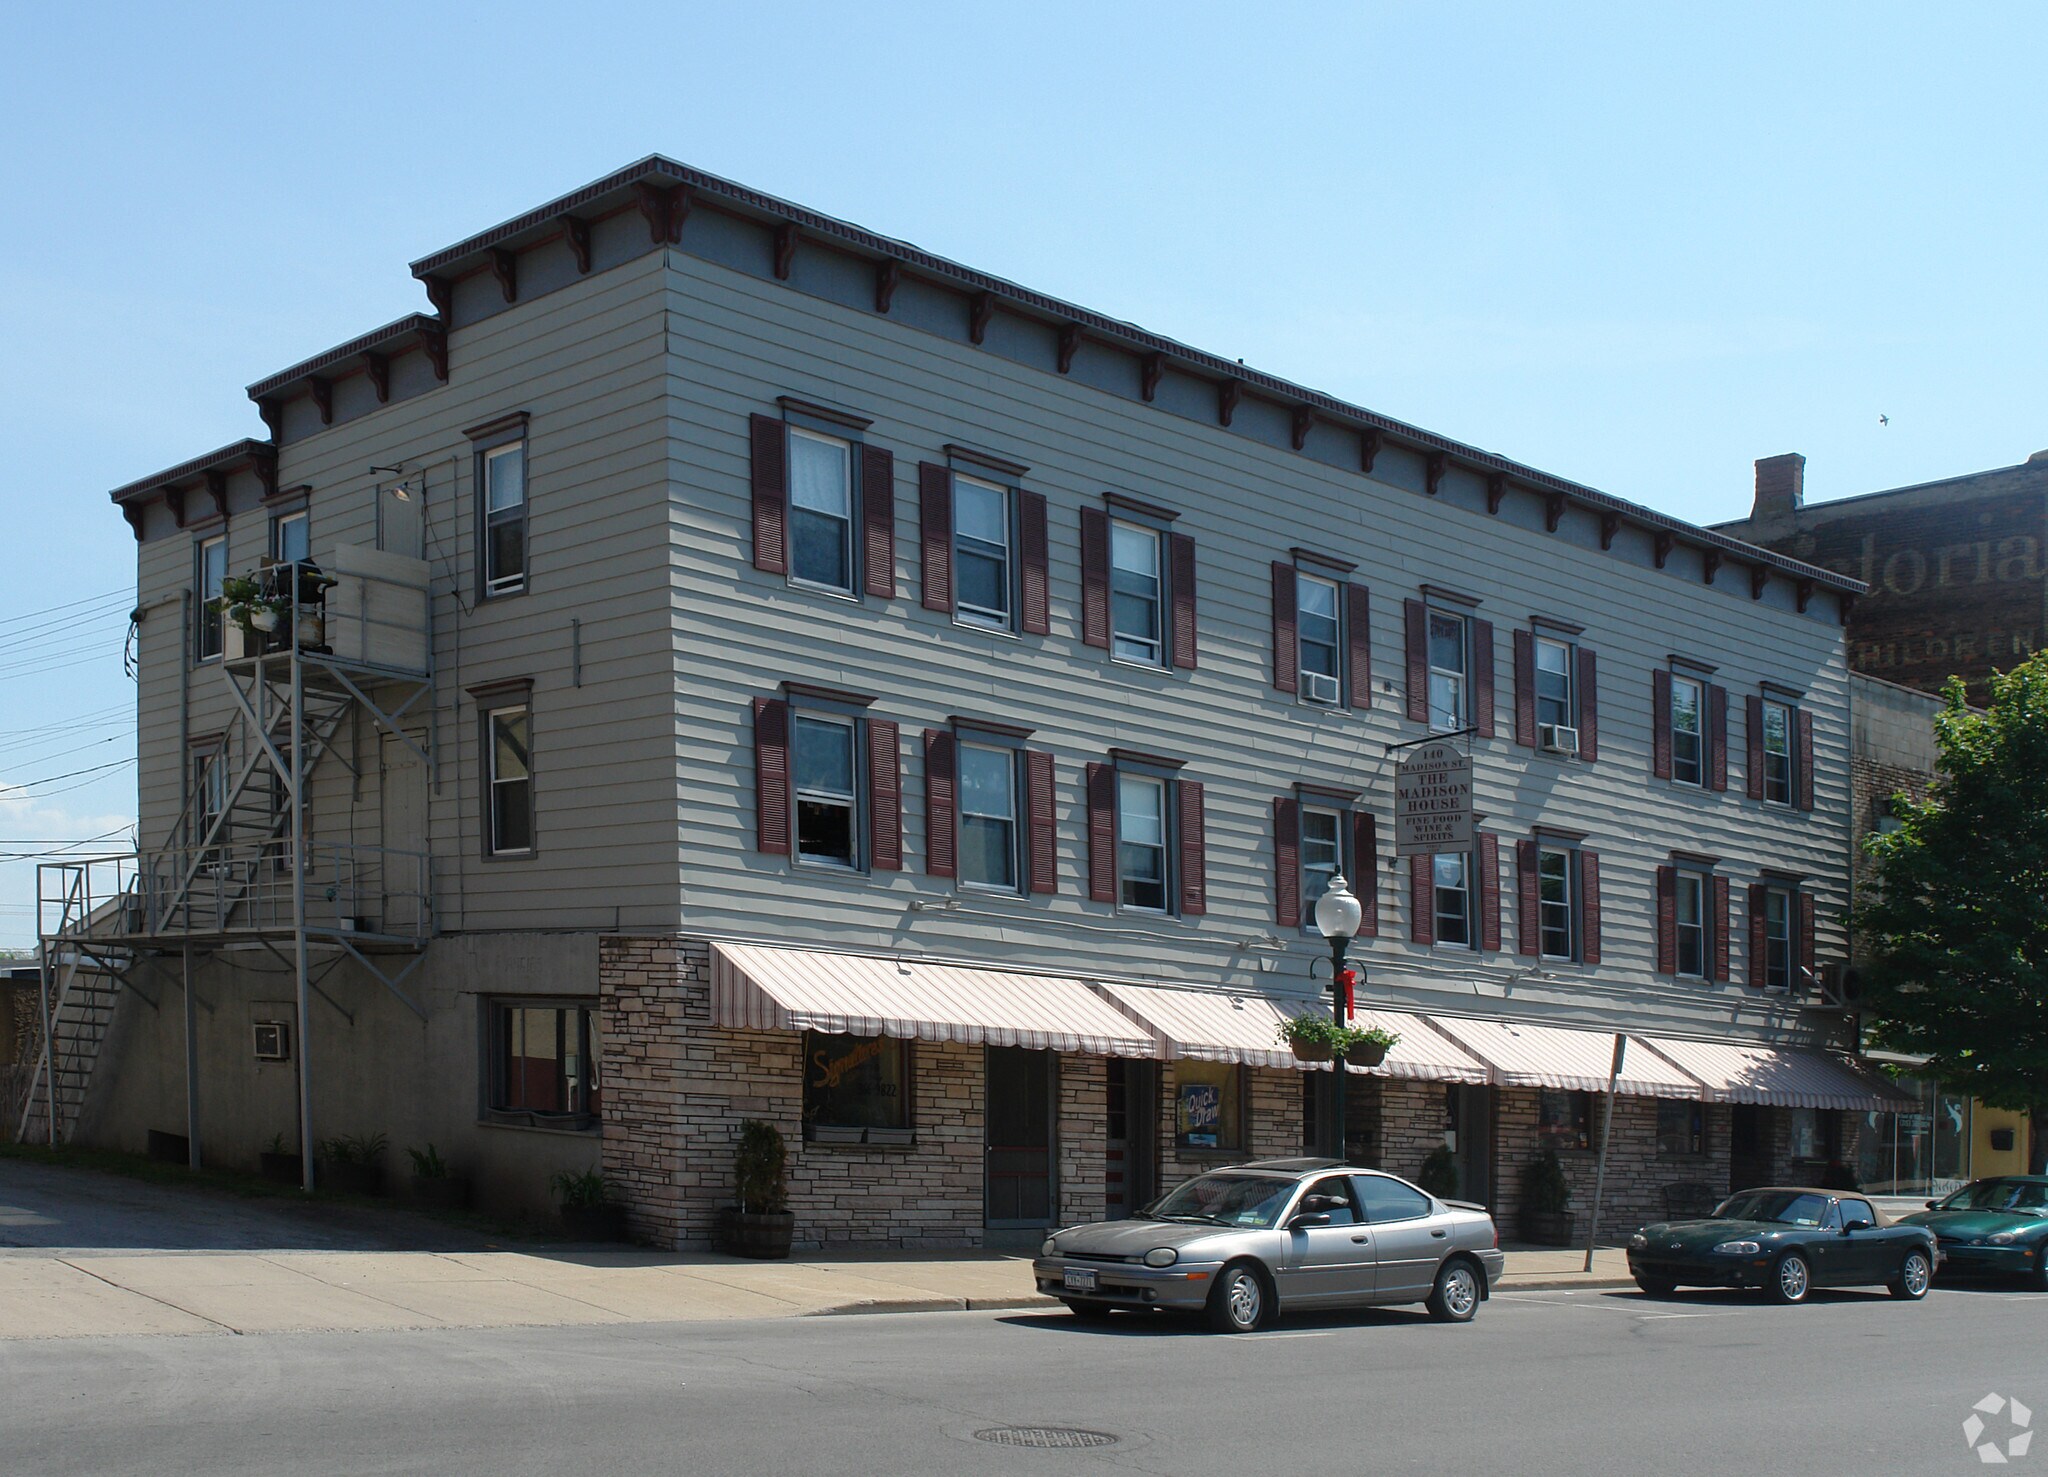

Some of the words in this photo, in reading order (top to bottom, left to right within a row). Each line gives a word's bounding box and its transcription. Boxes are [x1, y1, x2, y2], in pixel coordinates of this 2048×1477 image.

[1849, 629, 2034, 669] HILDREN
[1423, 749, 1444, 760] 140
[1402, 761, 1448, 771] MADISON
[1451, 759, 1466, 768] ST.
[1418, 773, 1448, 784] THE
[1399, 784, 1468, 799] MADISON
[1408, 798, 1460, 811] HOUSE
[1406, 815, 1430, 826] FINE
[1433, 813, 1462, 823] FOOD
[1415, 824, 1442, 833] WINE
[1413, 832, 1454, 842] SPIRITS
[1189, 1085, 1214, 1113] Quick
[1194, 1104, 1219, 1127] Draw
